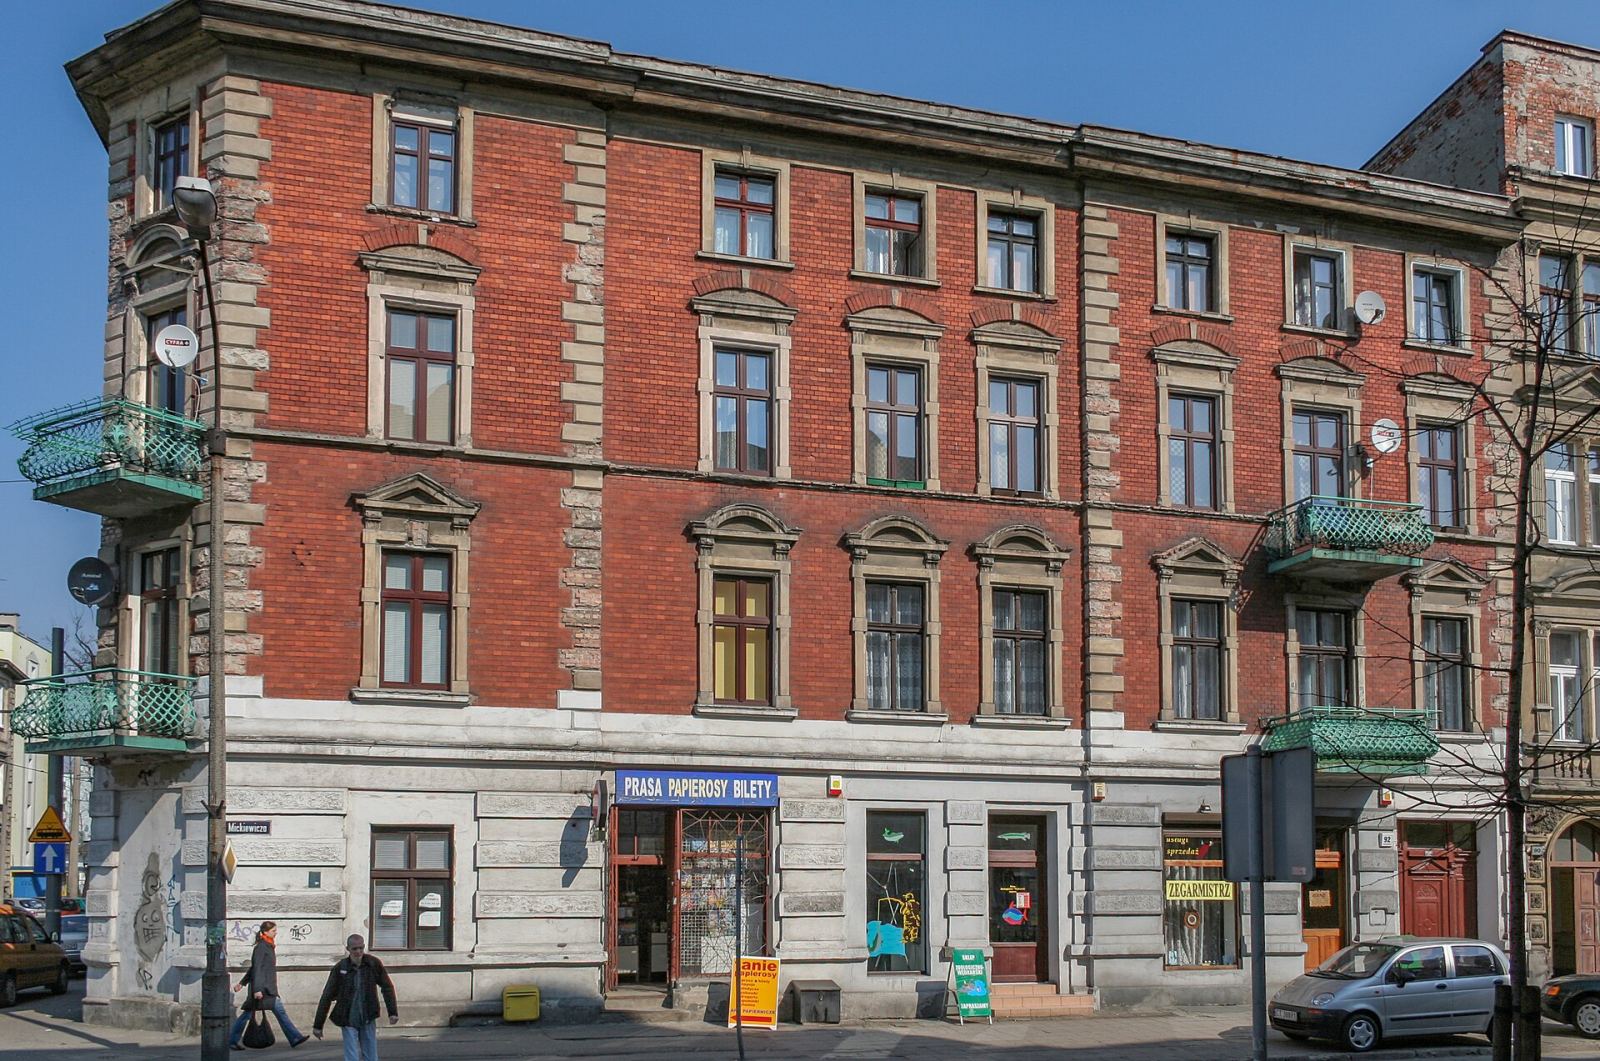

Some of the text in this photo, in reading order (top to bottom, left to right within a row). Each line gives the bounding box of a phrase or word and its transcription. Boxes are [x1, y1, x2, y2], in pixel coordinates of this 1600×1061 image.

[624, 777, 772, 800] PRASA PAPIEROSY BILETY
[228, 822, 268, 833] Mickiewicza
[1169, 882, 1231, 898] ZEGARMISTRZ
[735, 960, 778, 972] anie
